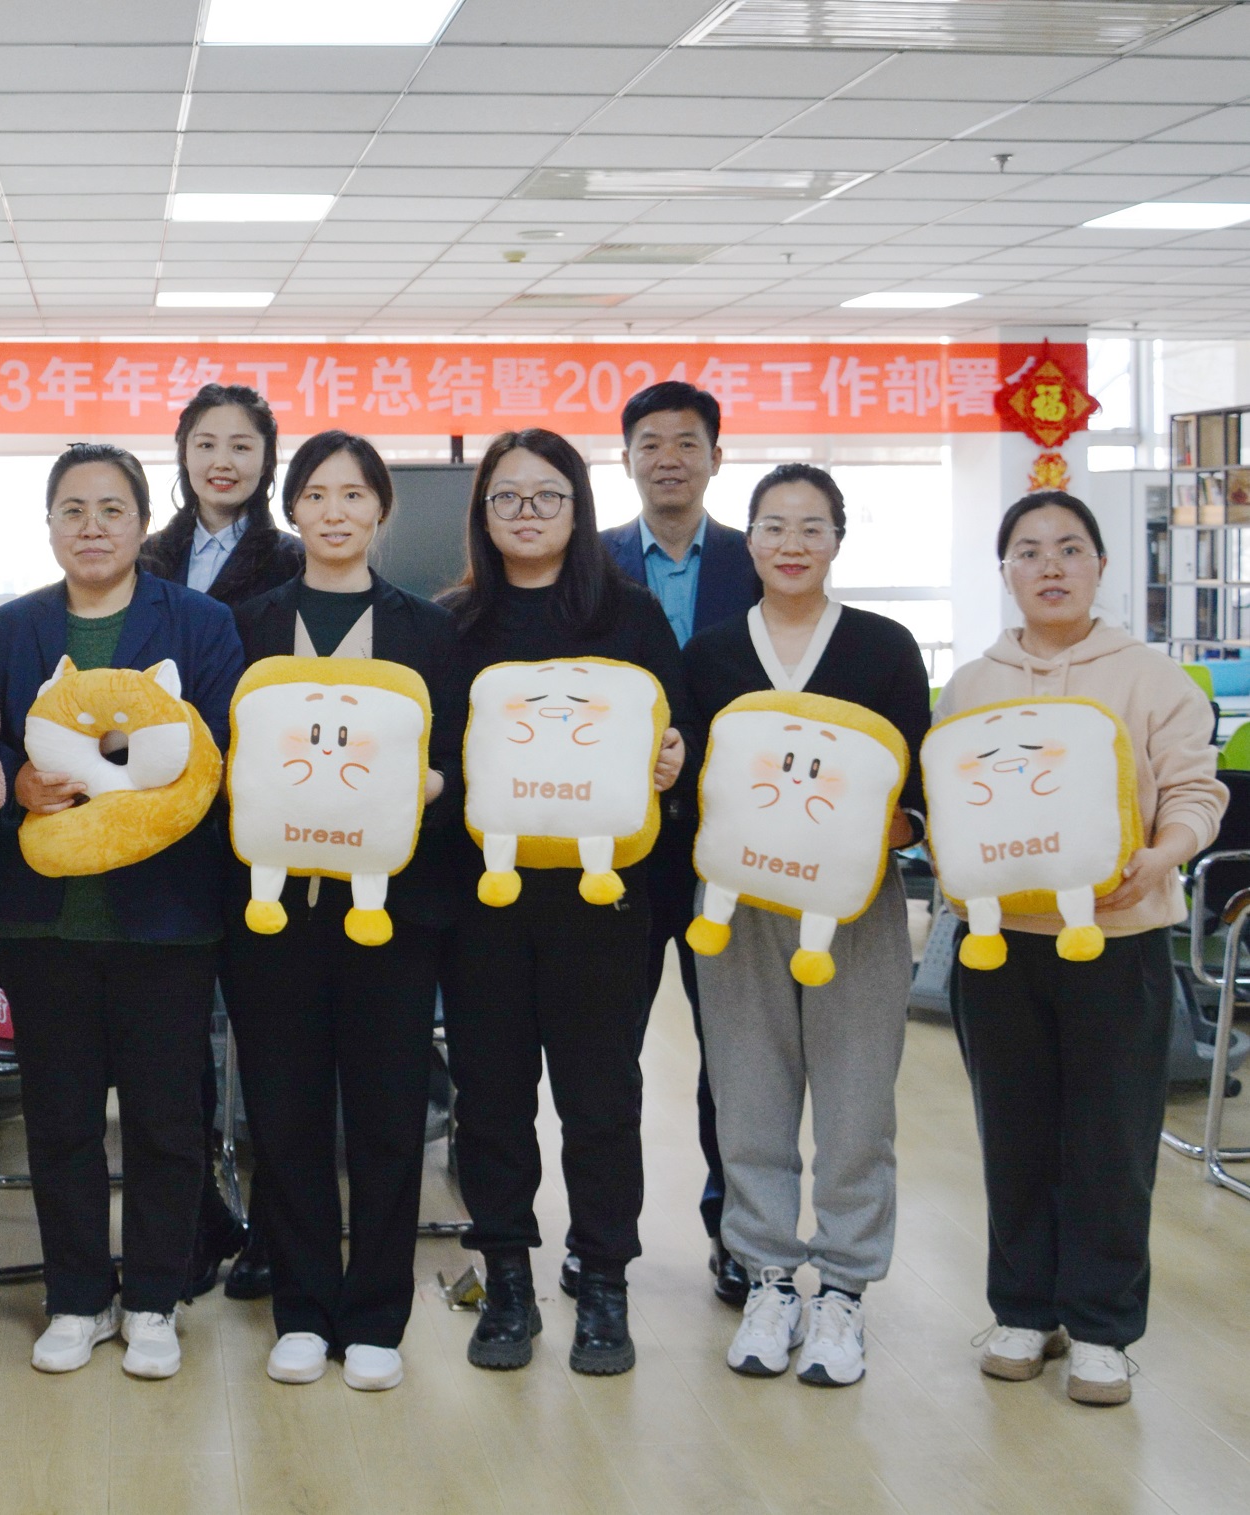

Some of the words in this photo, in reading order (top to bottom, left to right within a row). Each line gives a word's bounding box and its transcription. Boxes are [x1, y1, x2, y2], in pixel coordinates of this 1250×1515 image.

[1031, 384, 1068, 422] 福
[512, 777, 592, 801] bread
[284, 823, 364, 847] bread
[979, 831, 1061, 864] bread
[741, 845, 821, 882] bread
